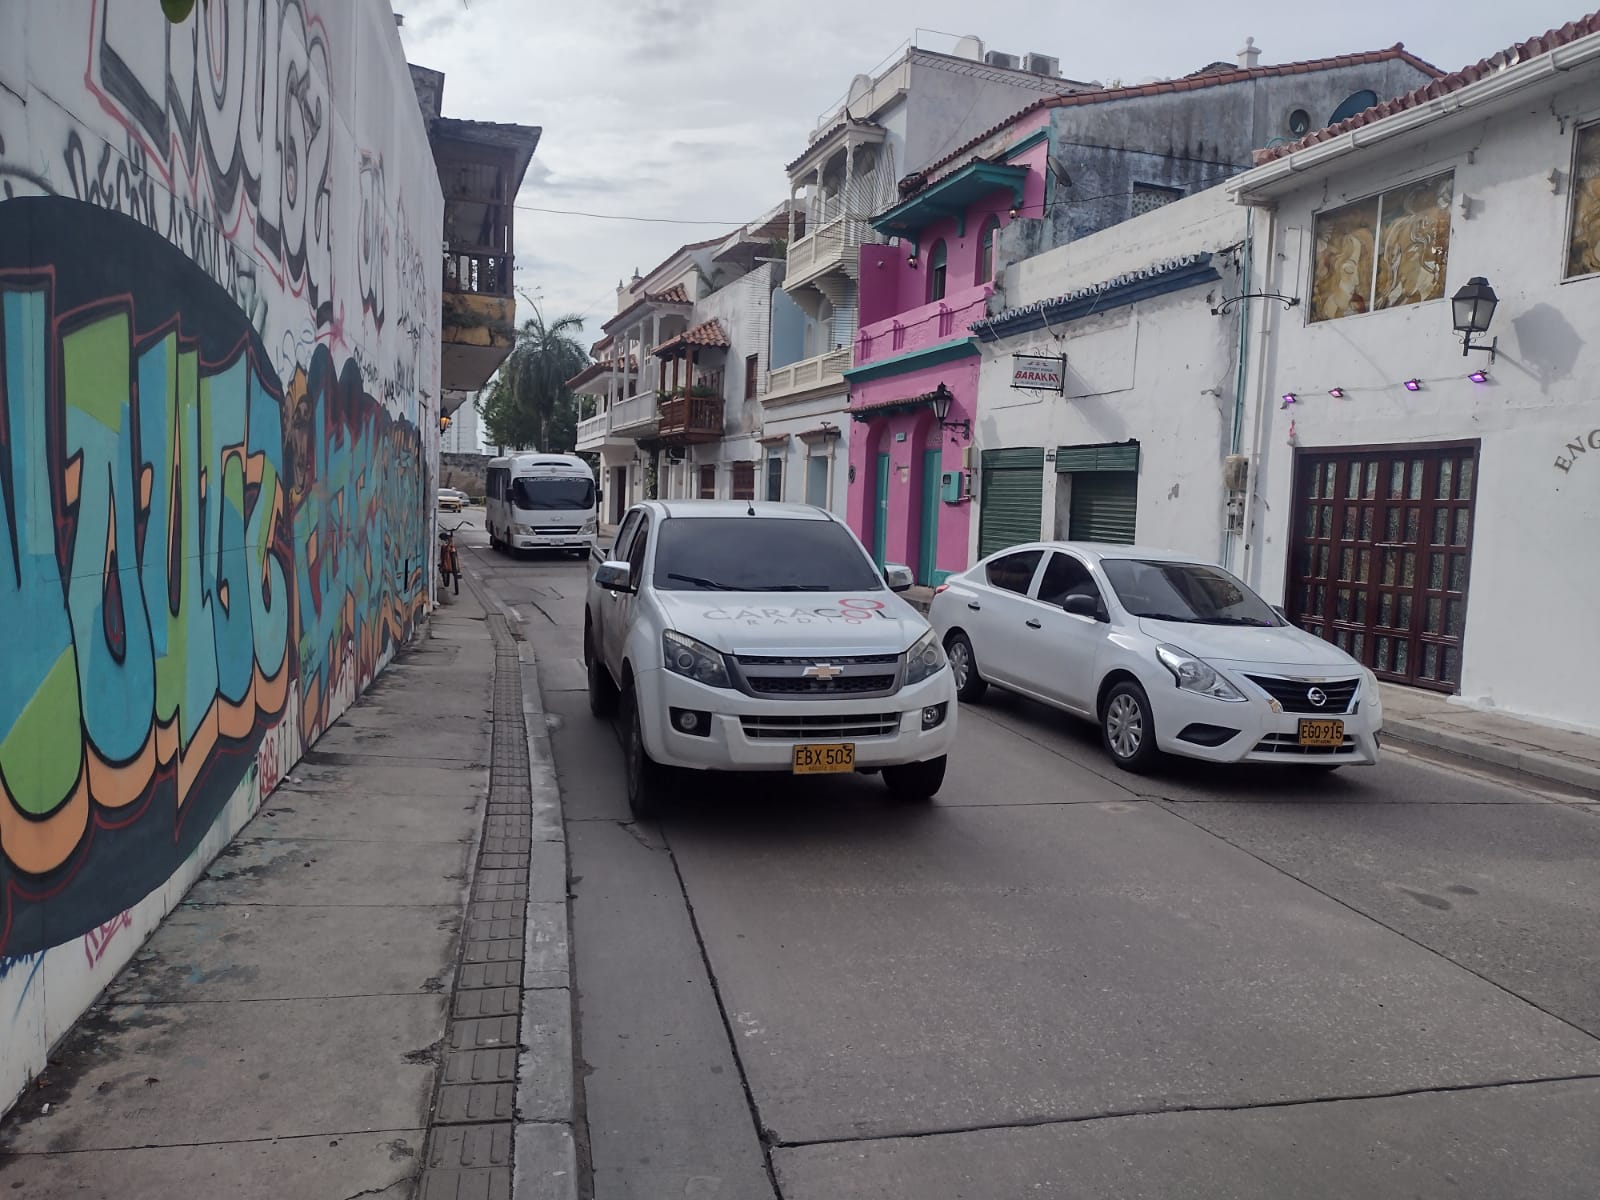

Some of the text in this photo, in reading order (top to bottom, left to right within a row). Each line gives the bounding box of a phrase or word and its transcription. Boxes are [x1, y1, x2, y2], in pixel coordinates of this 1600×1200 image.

[703, 604, 897, 620] CARACOL
[1323, 725, 1343, 740] 915
[796, 748, 853, 766] EBX 503
